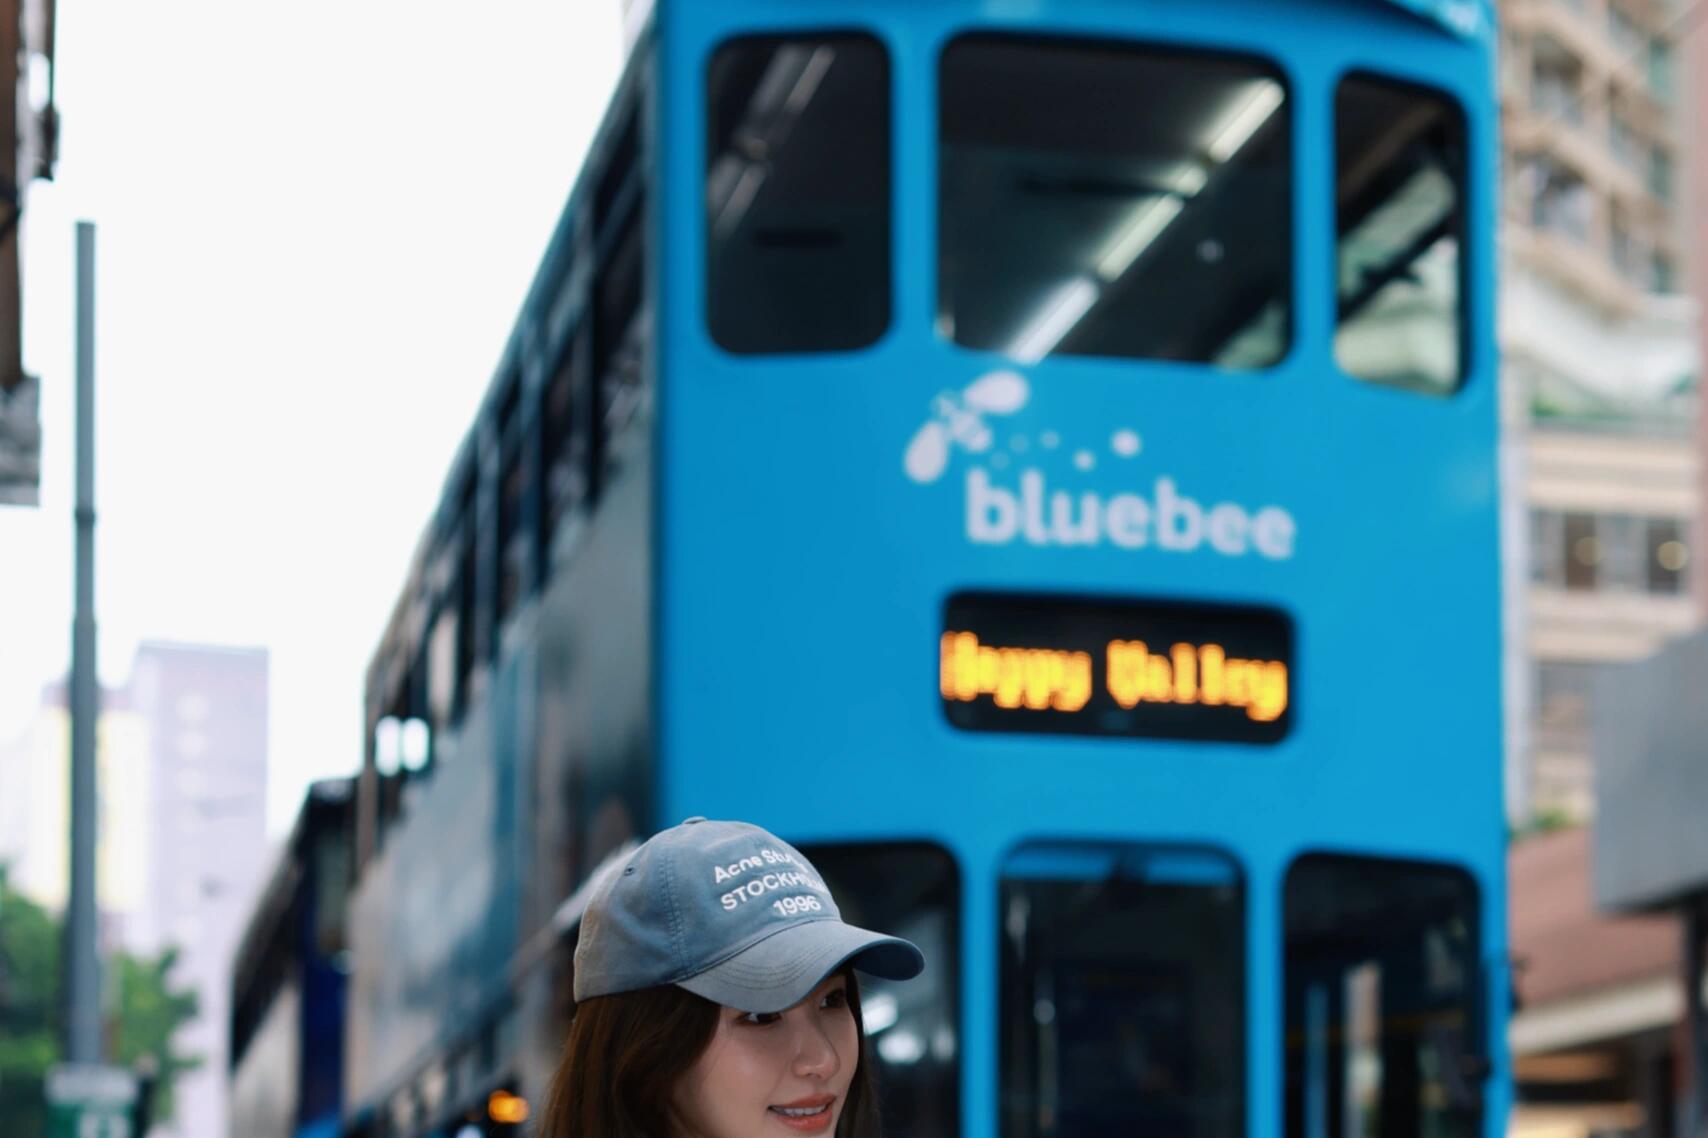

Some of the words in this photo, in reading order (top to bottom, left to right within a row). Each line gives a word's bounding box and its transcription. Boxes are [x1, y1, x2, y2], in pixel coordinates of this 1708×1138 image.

[965, 467, 1296, 560] bluebee
[713, 855, 763, 883] Acne
[773, 895, 822, 916] 1996
